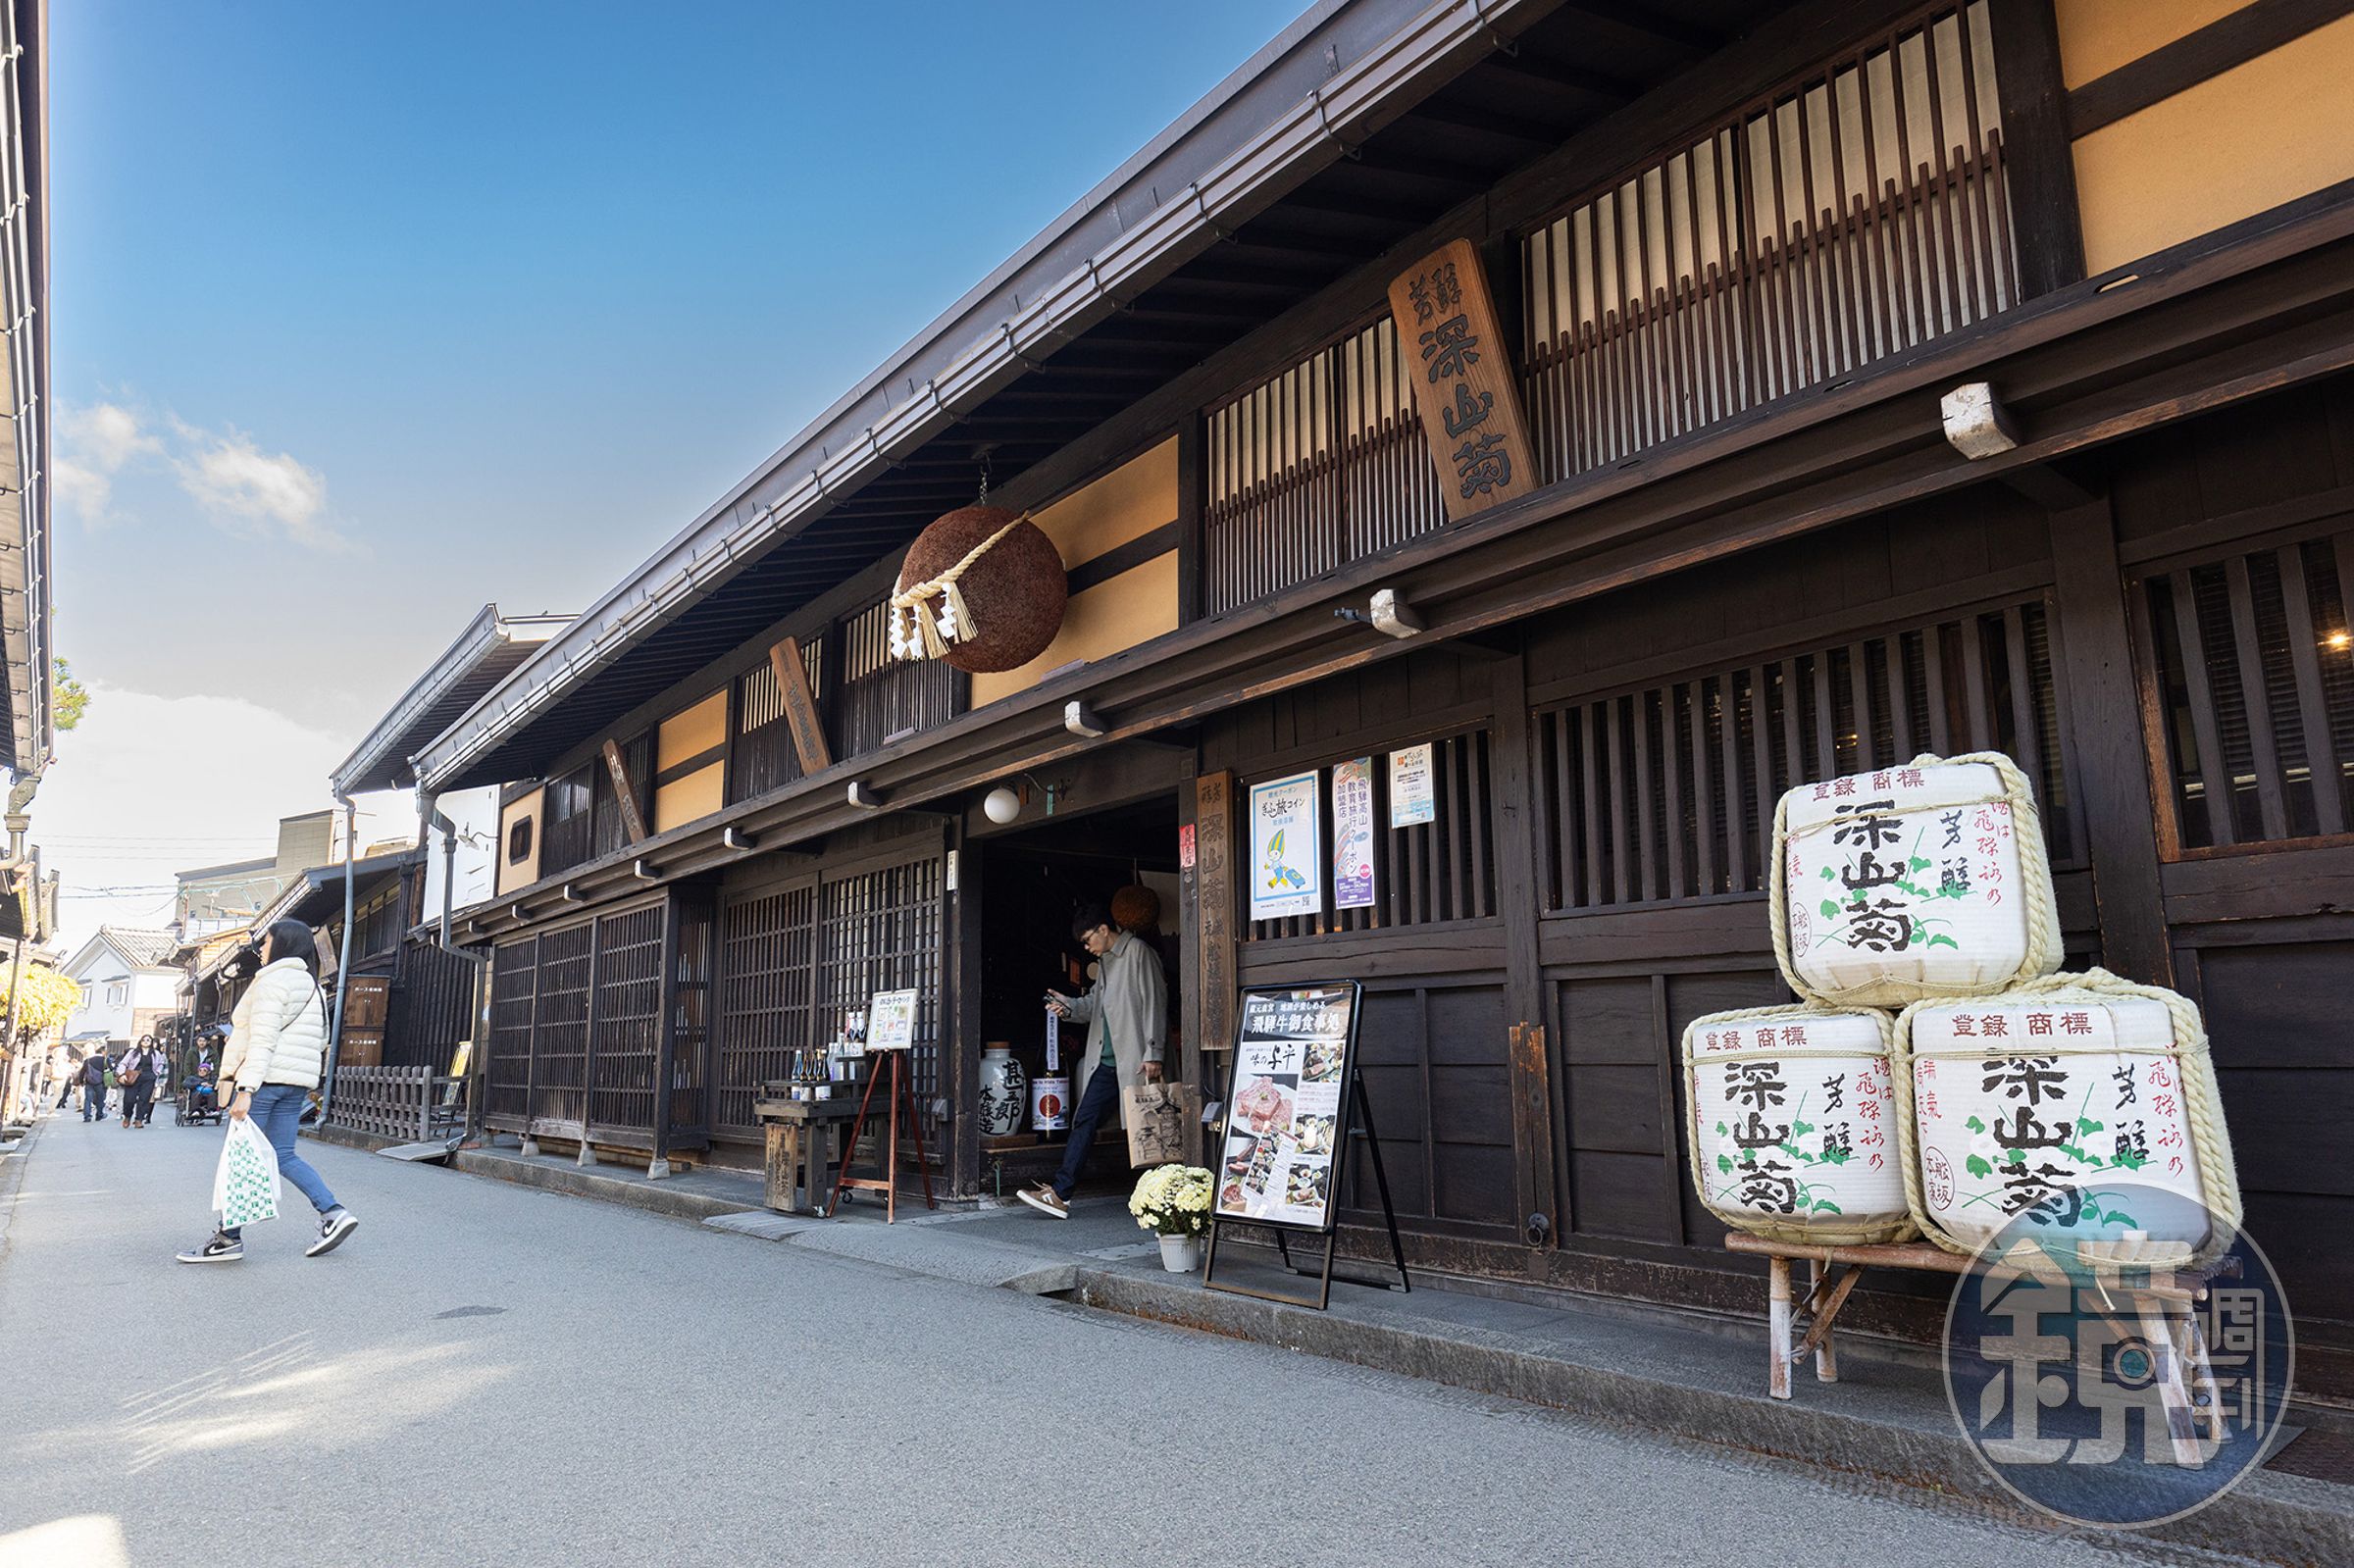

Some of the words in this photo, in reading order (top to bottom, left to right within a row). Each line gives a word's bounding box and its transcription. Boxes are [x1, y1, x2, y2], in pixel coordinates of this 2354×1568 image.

[1418, 314, 1511, 499] 深山菊
[1262, 798, 1305, 819] ぎふ旅コイン
[1338, 784, 1347, 819] 加盟店
[1358, 779, 1367, 826] 飛騨高山
[1814, 769, 1924, 801] 登録商標
[1349, 782, 1357, 875] 教育旅行クーポン
[1201, 813, 1225, 910] 深山菊
[1833, 799, 1912, 952] 深山菊
[1252, 1012, 1340, 1034] 飛騨牛御食事処
[1706, 1026, 1808, 1051] 登録商標
[1952, 1012, 2093, 1037] 登録商標
[996, 1060, 1024, 1131] 甚五郎
[1724, 1062, 1797, 1214] 深山菊
[1981, 1046, 2081, 1228] 深山菊
